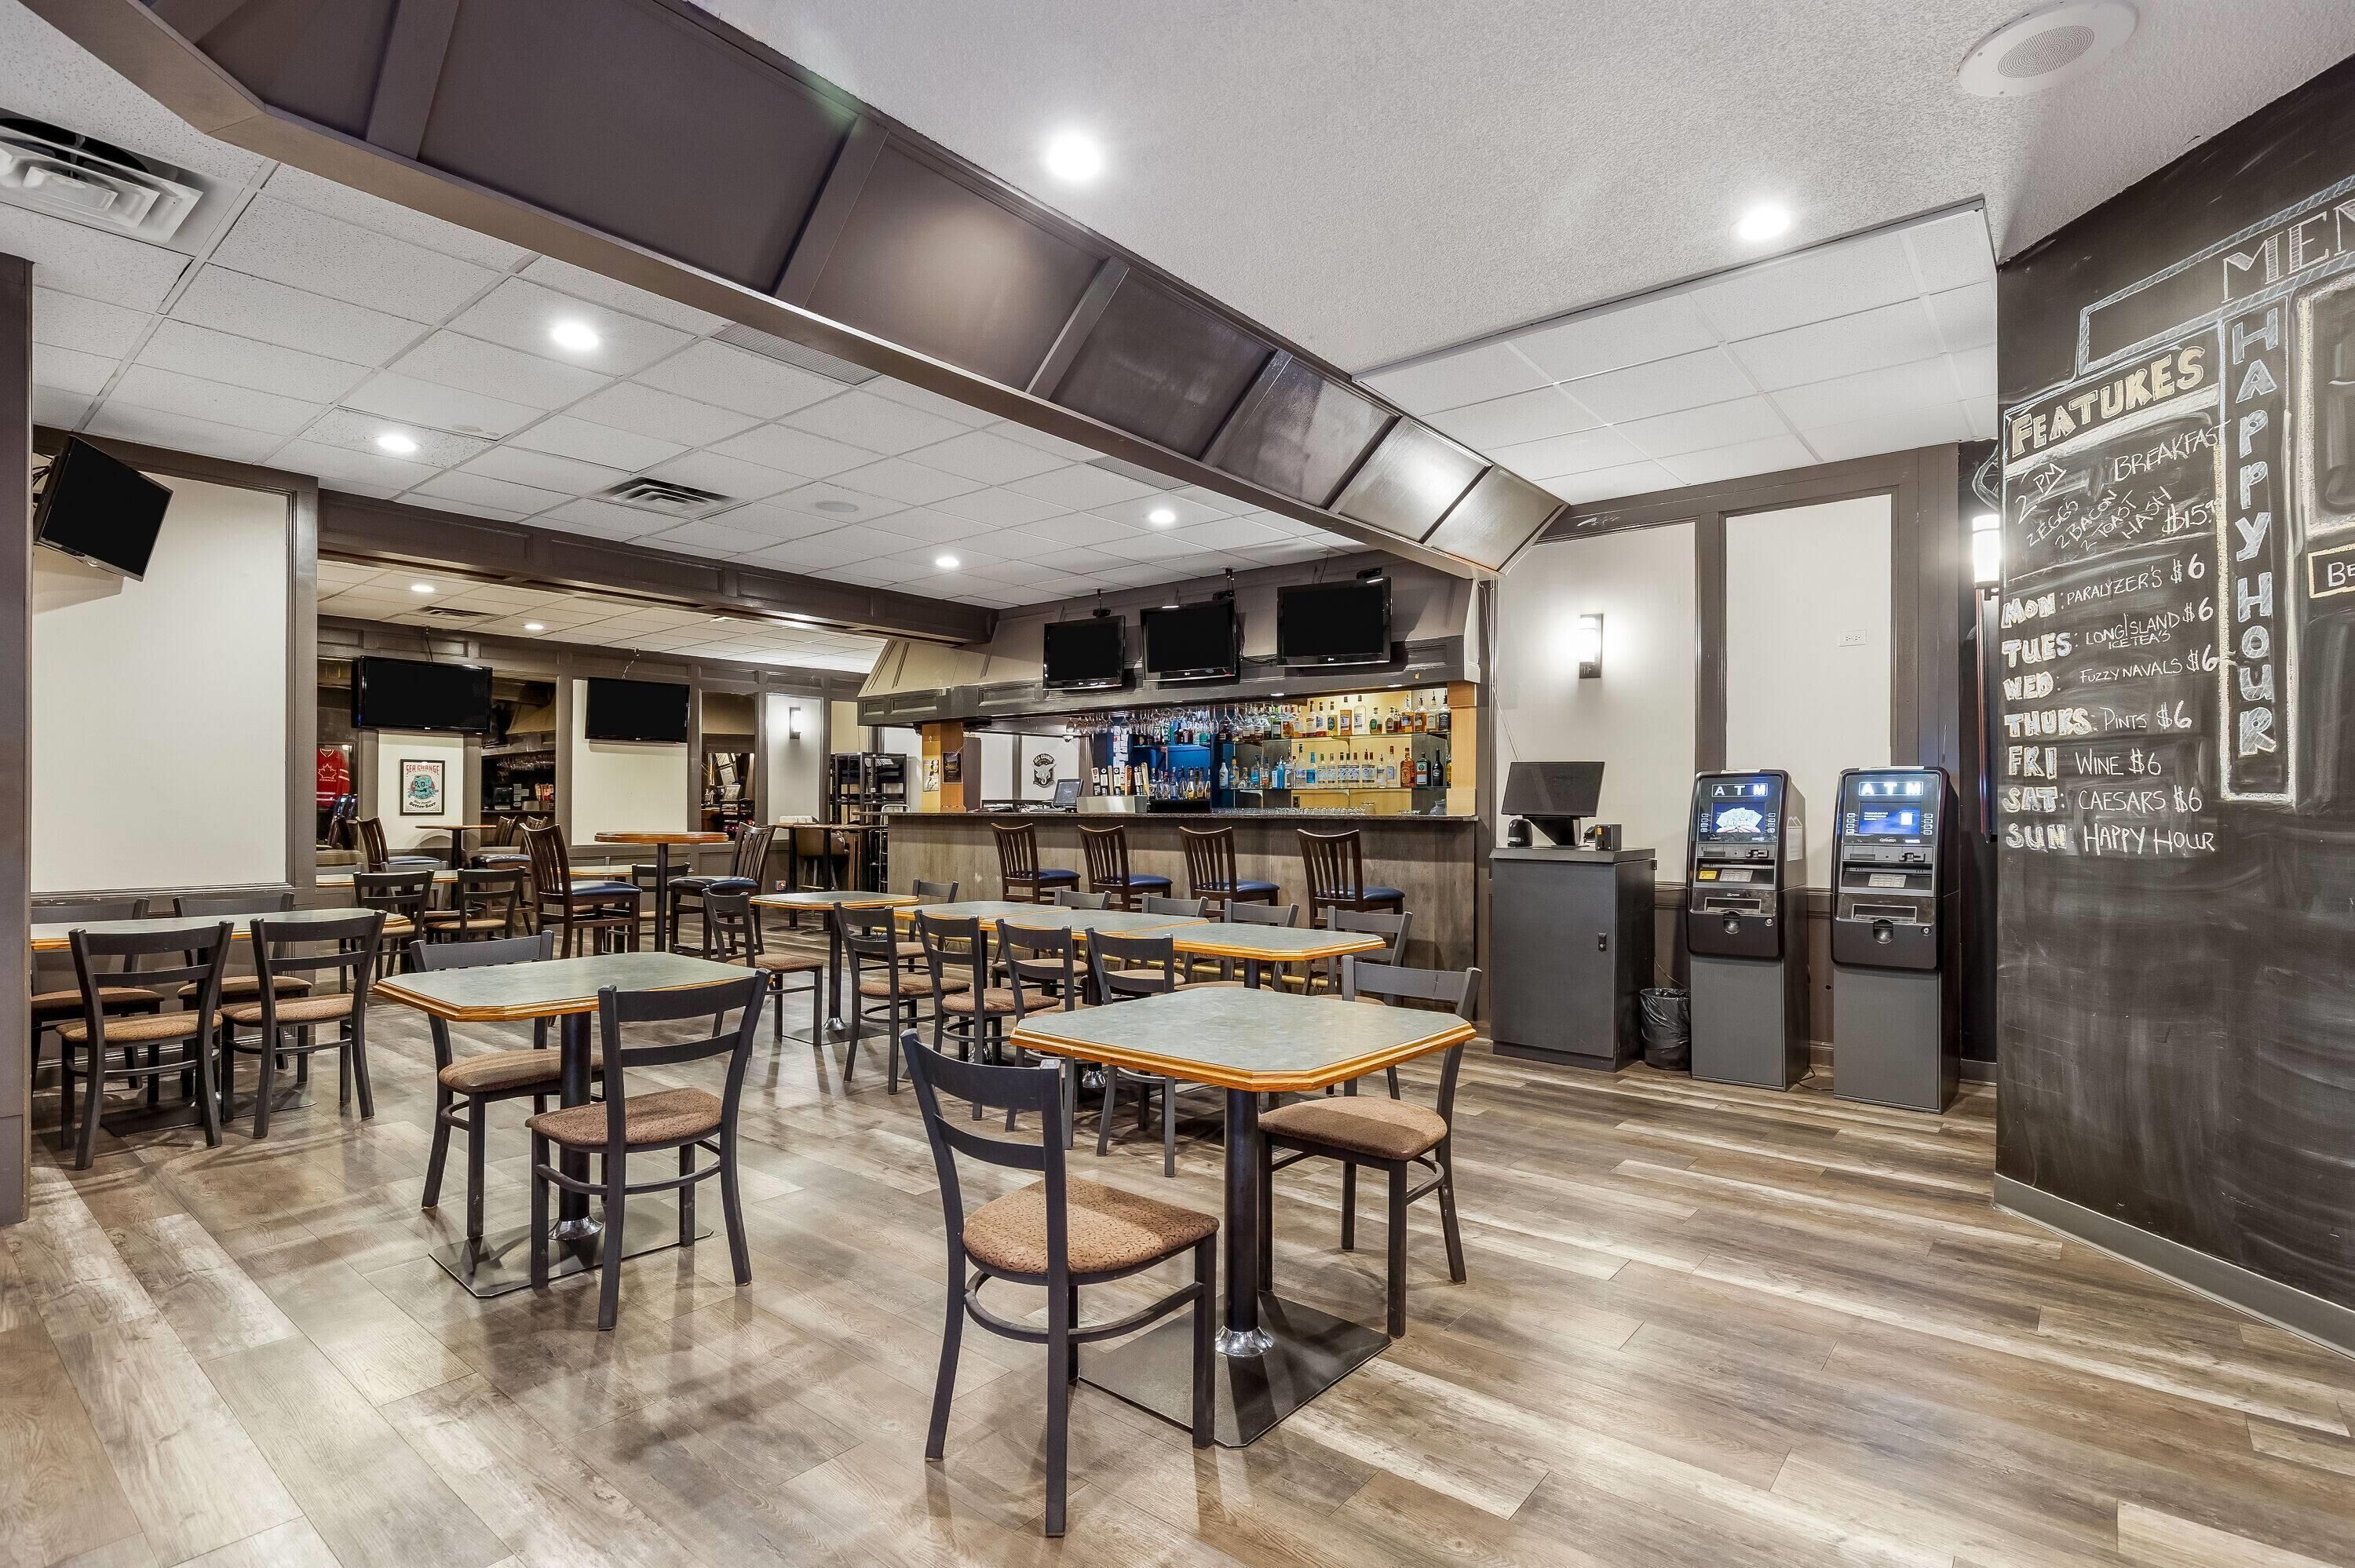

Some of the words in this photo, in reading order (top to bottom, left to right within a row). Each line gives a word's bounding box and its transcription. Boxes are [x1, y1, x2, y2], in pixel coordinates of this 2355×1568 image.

[2011, 345, 2206, 458] FEATURES
[2114, 419, 2231, 482] BREAKFAST
[2066, 490, 2118, 542] BACON
[2091, 490, 2138, 538] TOAST
[2121, 486, 2172, 539] HASH
[2156, 700, 2193, 730] $6
[2008, 746, 2057, 780] FRI
[2128, 748, 2162, 775] $6
[2078, 790, 2166, 813] CAESARS
[2174, 785, 2202, 813] $6
[2083, 823, 2145, 855] HAPPY
[2153, 827, 2216, 855] HOUR
